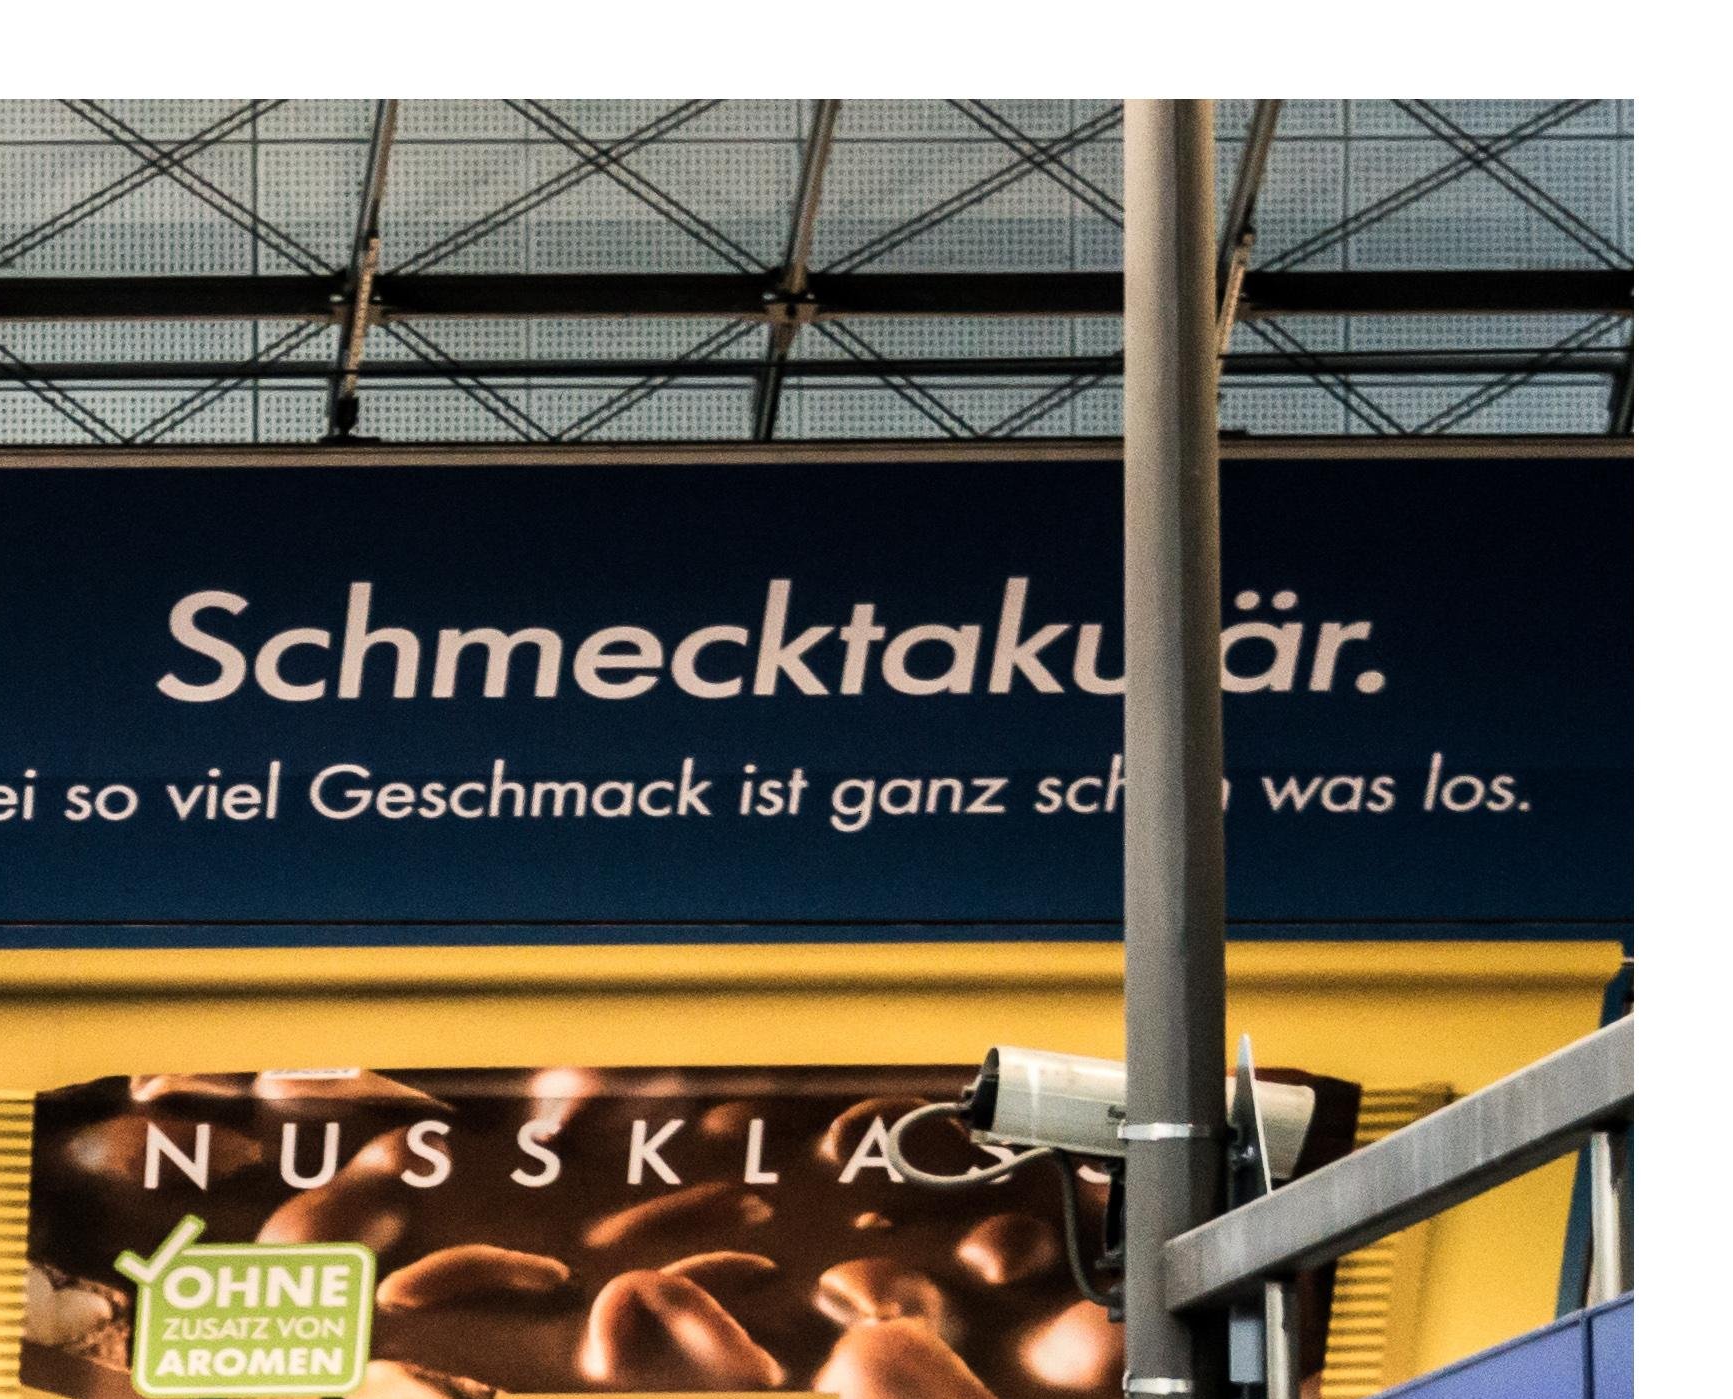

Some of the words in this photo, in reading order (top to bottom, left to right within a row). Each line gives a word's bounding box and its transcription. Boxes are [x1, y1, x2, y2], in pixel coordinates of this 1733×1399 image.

[156, 576, 1386, 703] Schmecktakuär.
[64, 781, 138, 821] so
[167, 760, 281, 821] viel
[309, 758, 713, 820] Geschmack
[738, 763, 808, 817] ist
[830, 776, 1010, 833] ganz
[1034, 753, 1232, 814] sch
[1261, 775, 1396, 813] was
[1423, 751, 1532, 813] los.
[162, 1264, 351, 1309] OHNE
[161, 1316, 270, 1341] ZUSATZ
[278, 1316, 347, 1339] VON
[154, 1346, 344, 1378] AROMEN
